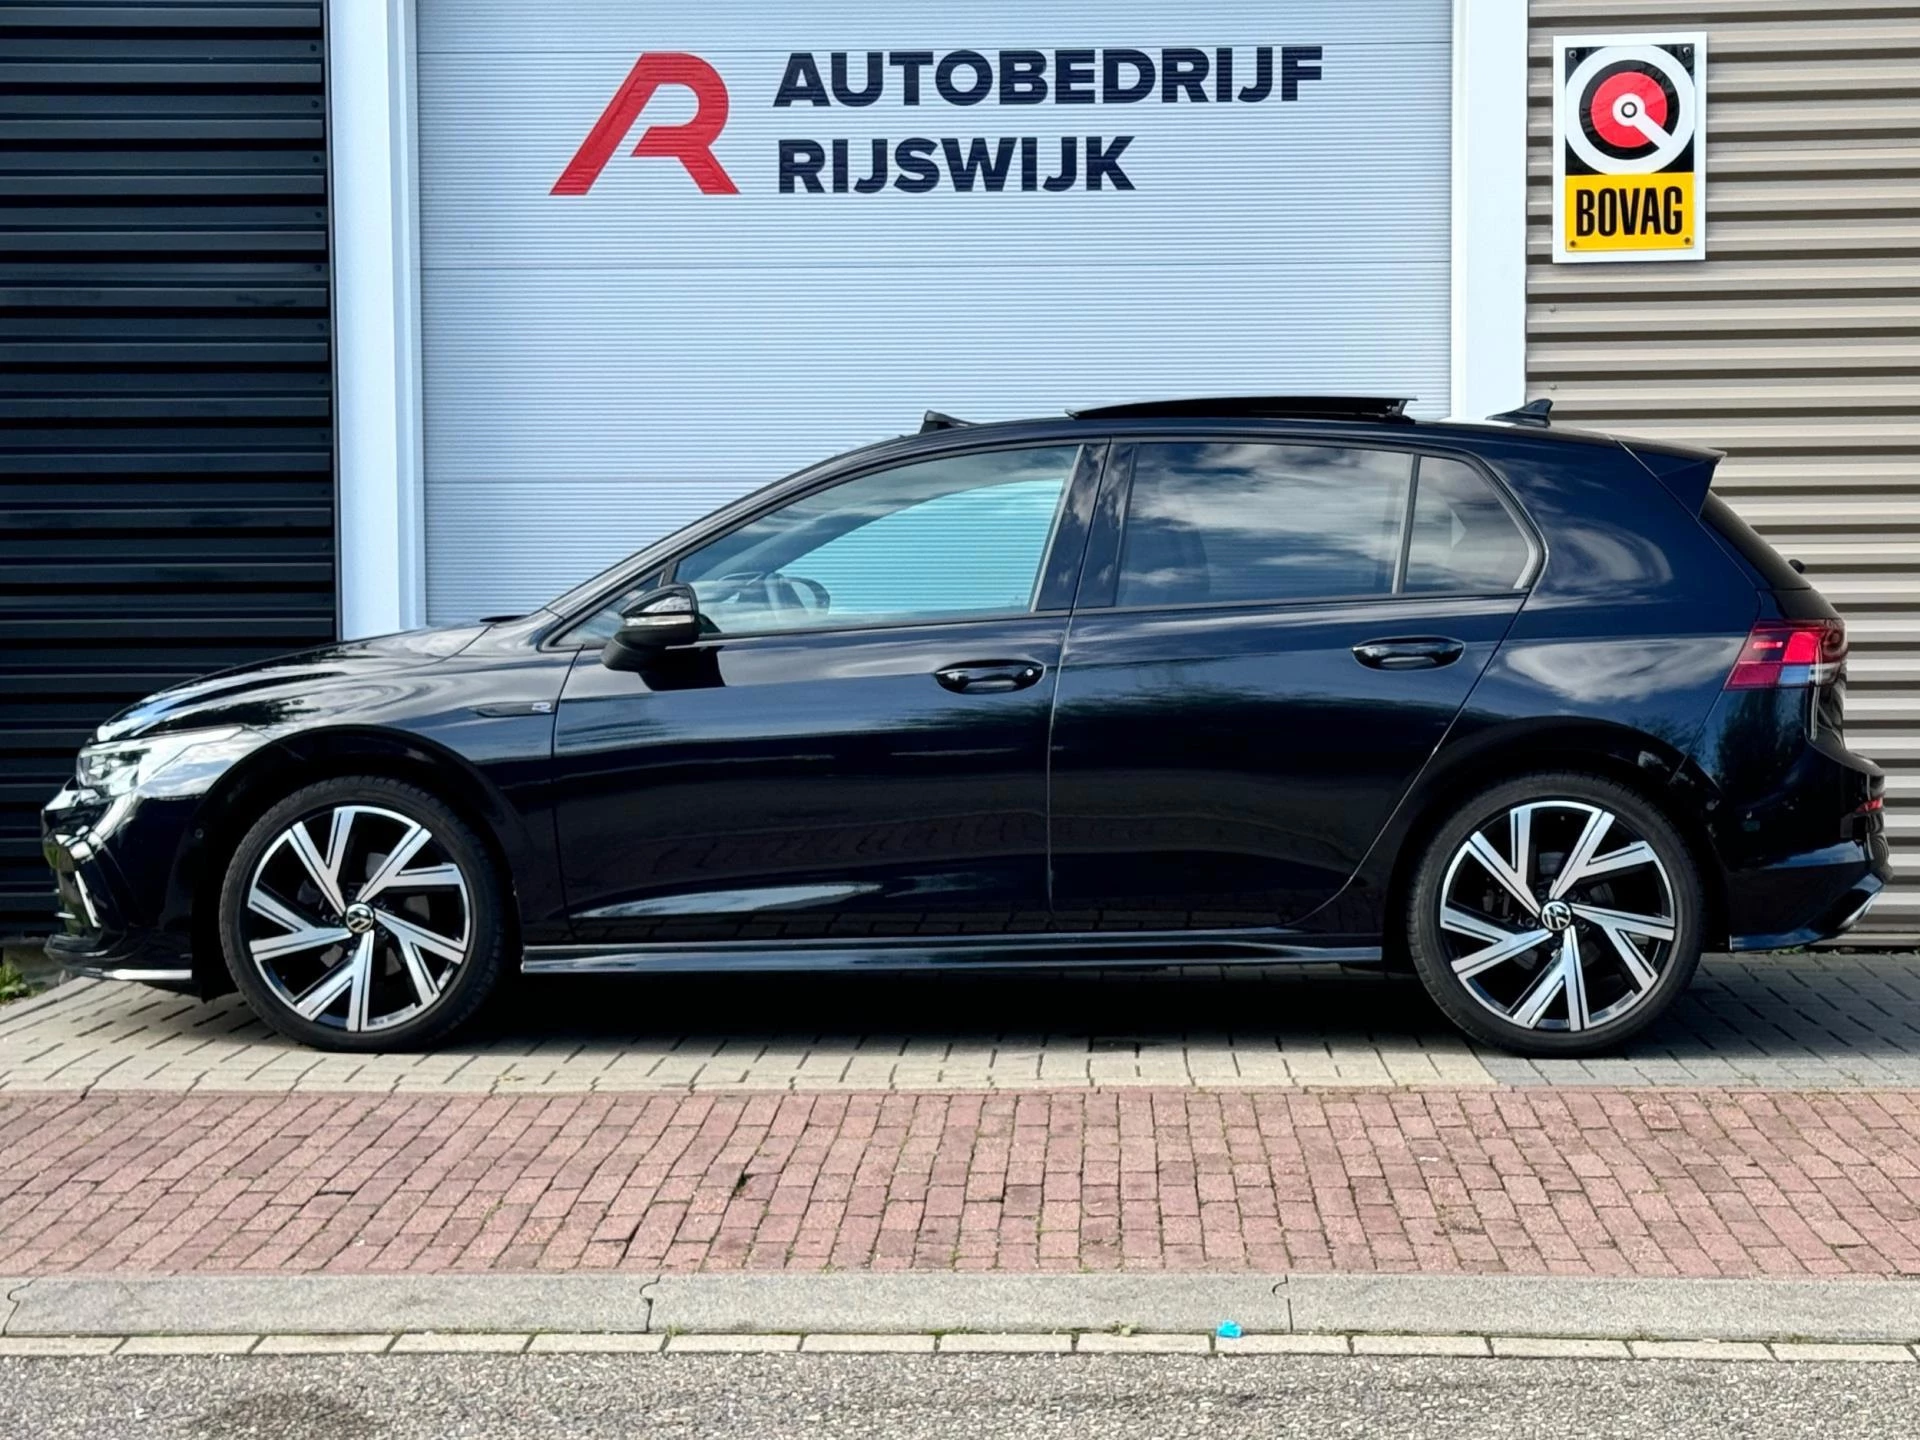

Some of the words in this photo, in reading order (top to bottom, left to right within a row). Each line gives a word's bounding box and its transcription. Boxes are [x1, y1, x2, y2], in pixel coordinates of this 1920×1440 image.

[773, 46, 1322, 107] AUTOBEDRIJF
[779, 136, 1136, 193] RIJSWIJK
[1576, 186, 1682, 237] BOVAG
